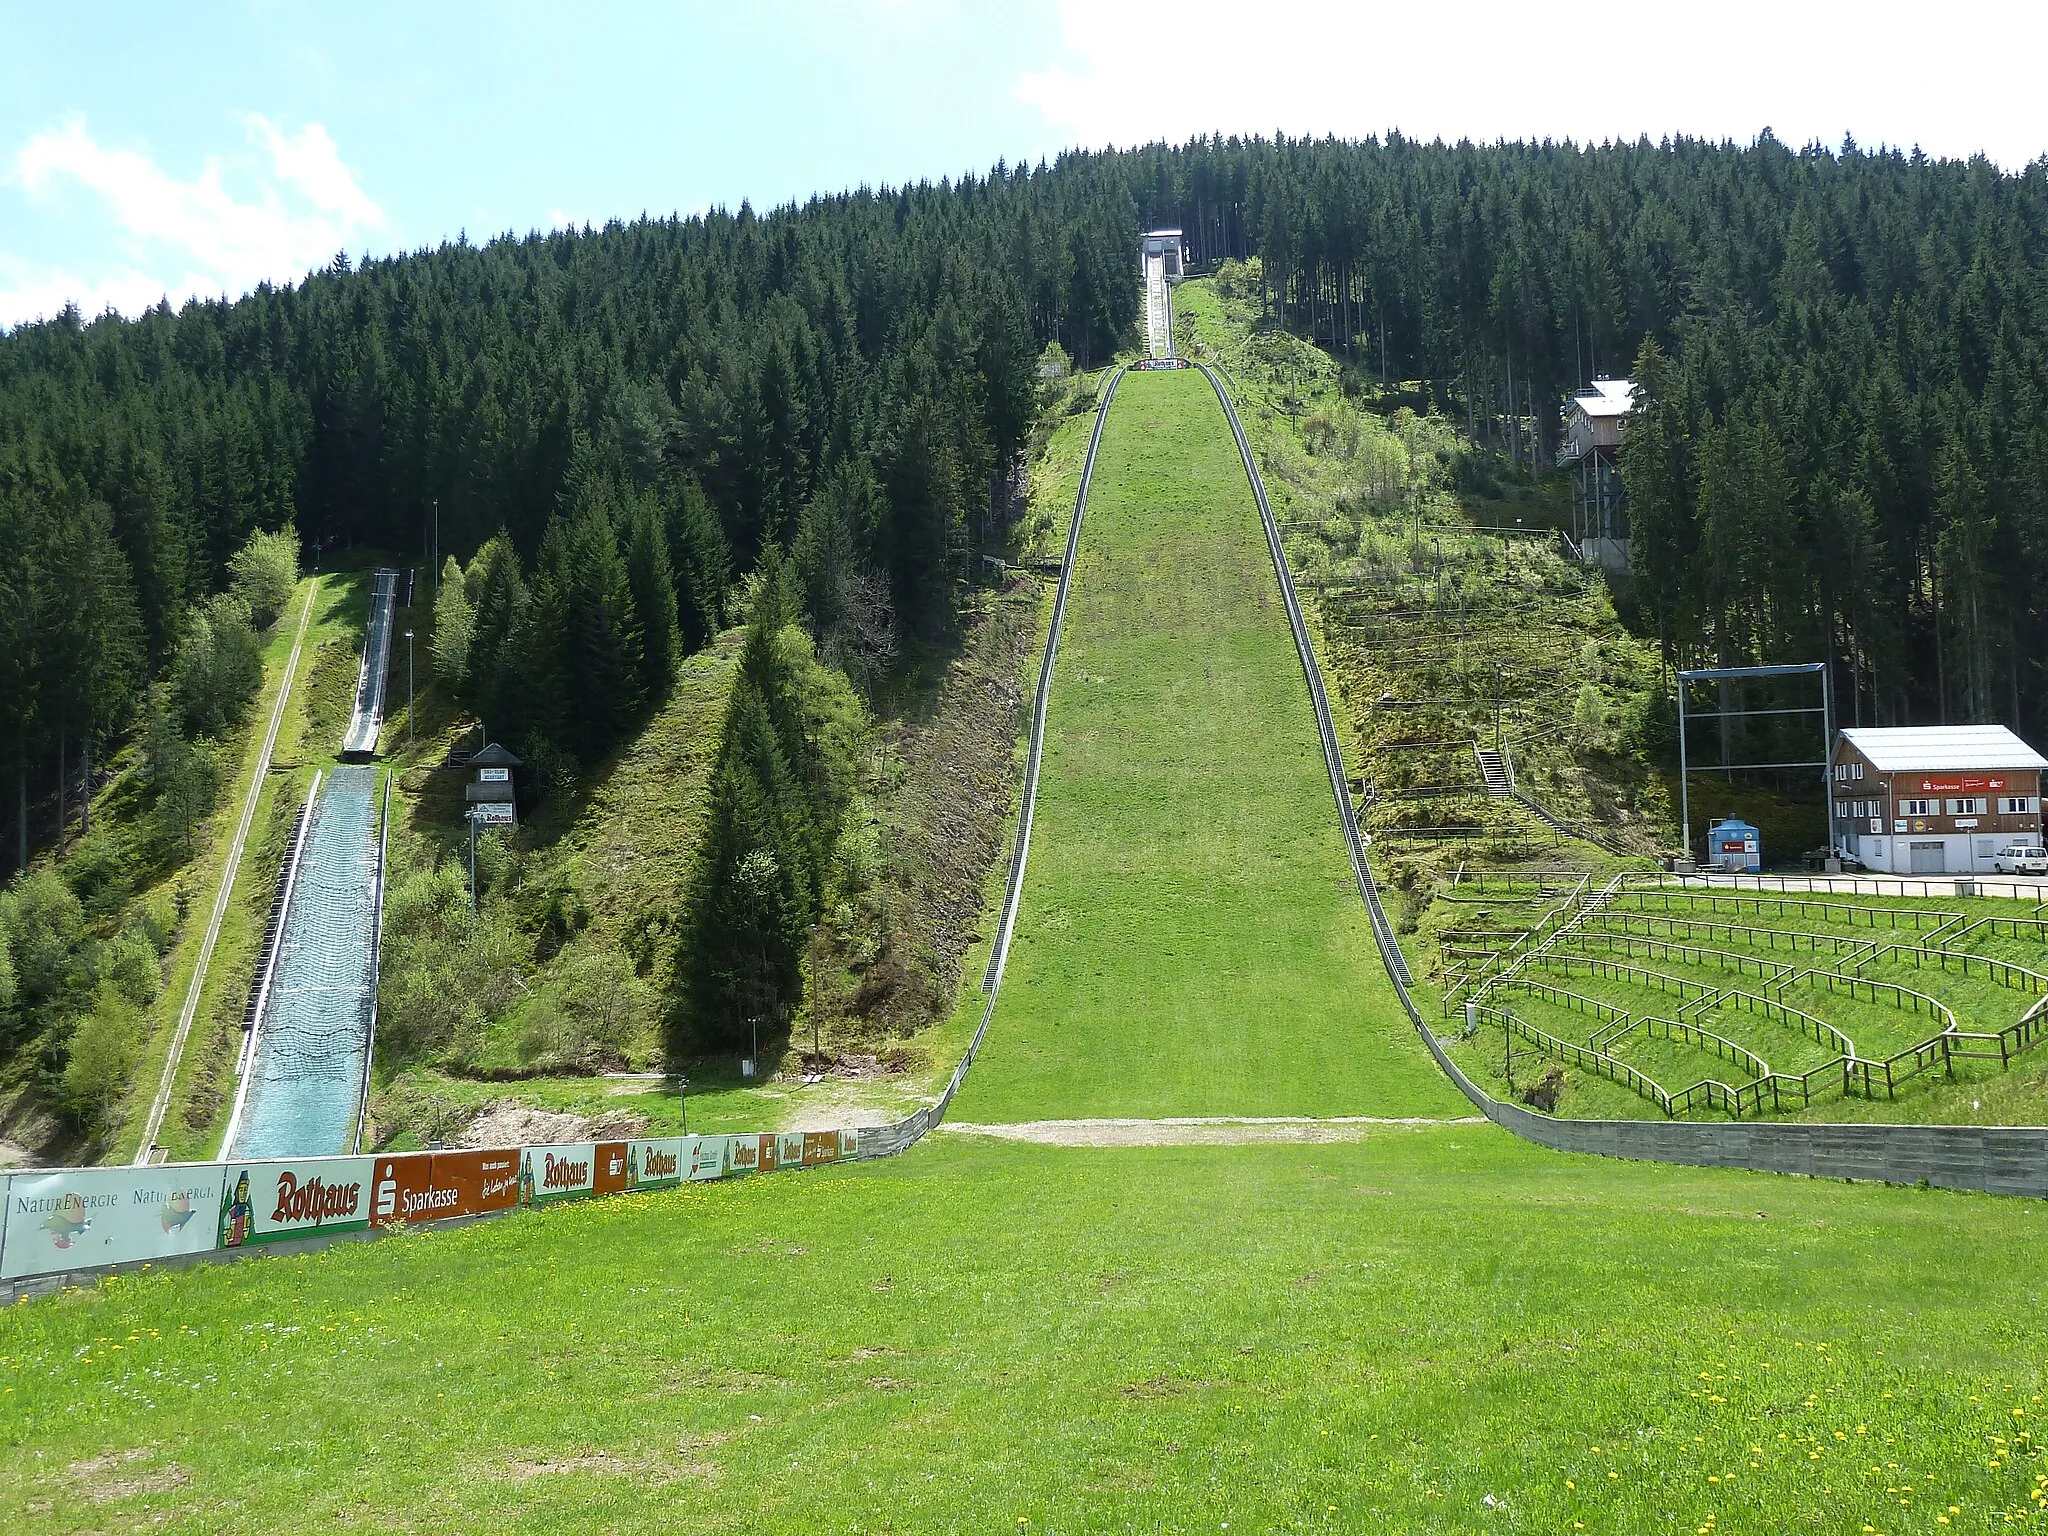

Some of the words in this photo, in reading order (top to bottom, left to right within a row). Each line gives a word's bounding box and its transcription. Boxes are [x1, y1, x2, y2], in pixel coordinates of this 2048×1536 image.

[486, 814, 511, 822] Rothaus
[643, 1145, 677, 1177] Rothaus
[733, 1139, 757, 1168] Rothaus
[543, 1152, 589, 1191] Rothaus
[270, 1170, 360, 1227] Rothaus
[401, 1184, 458, 1217] Sparkasse
